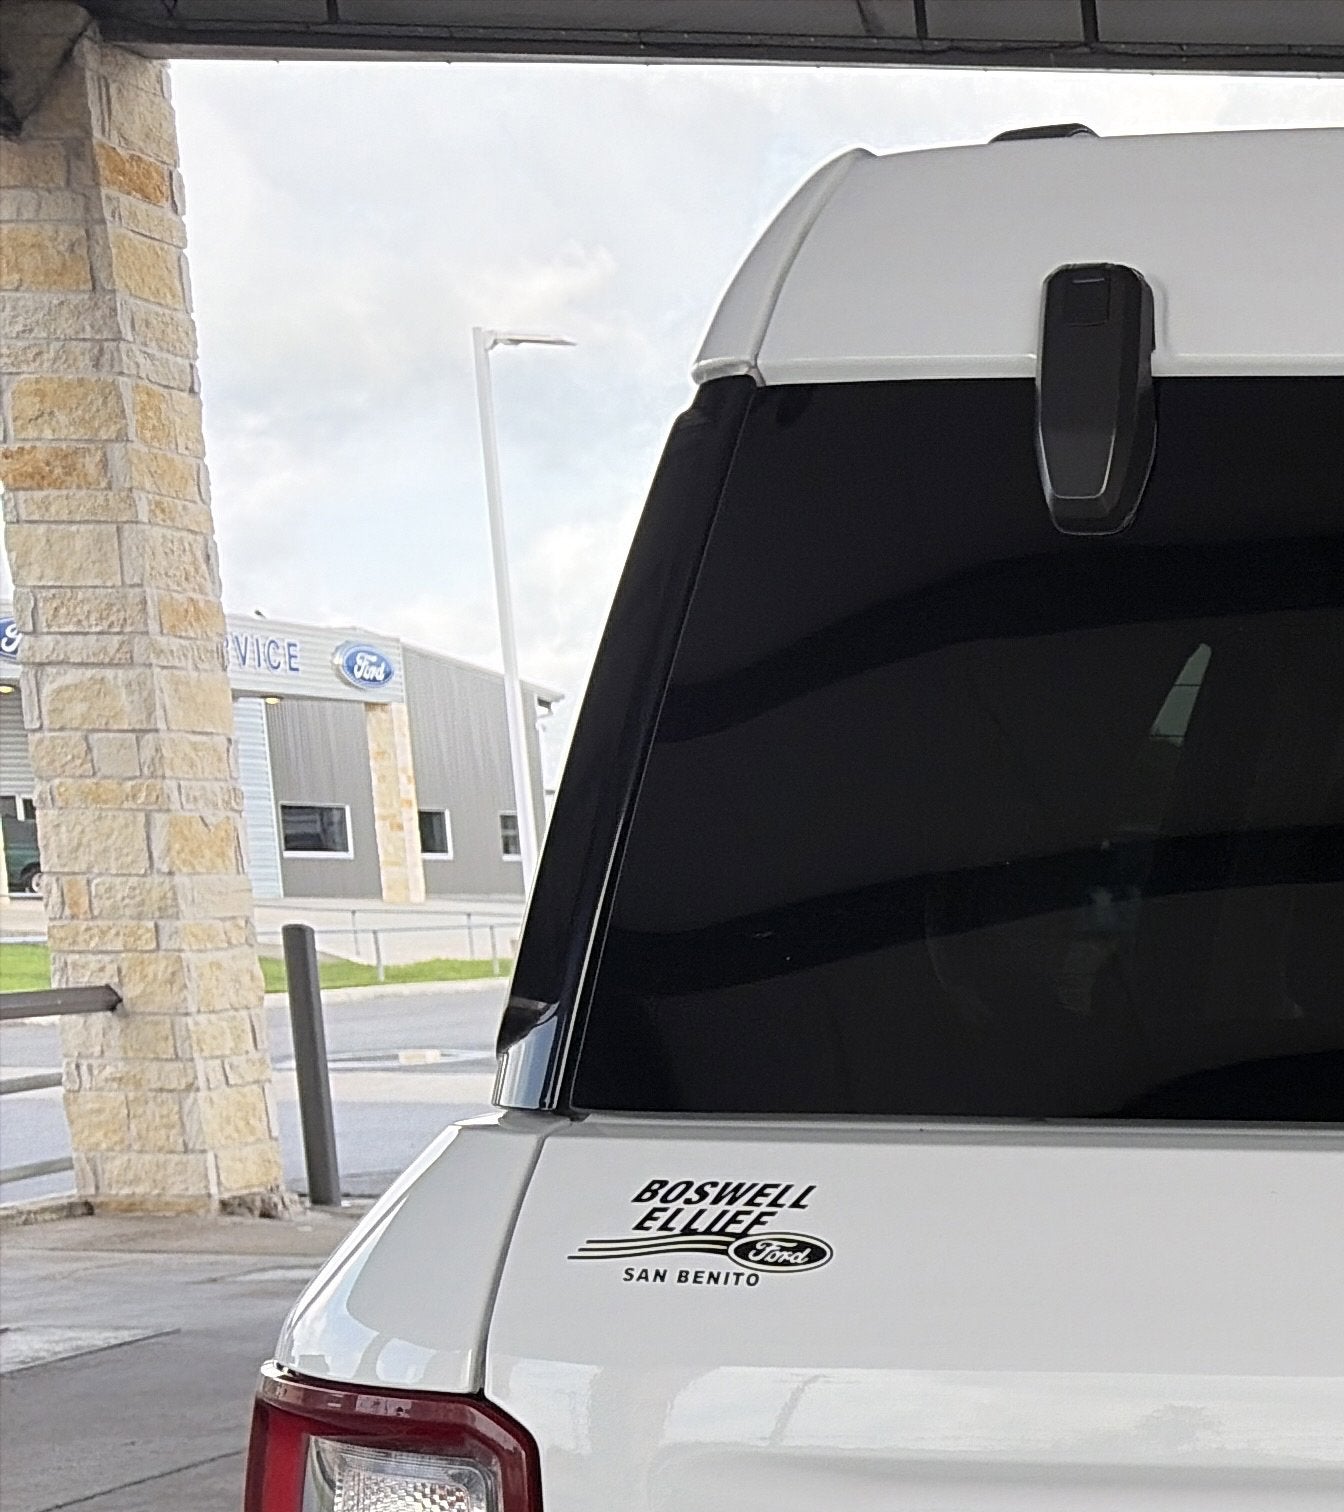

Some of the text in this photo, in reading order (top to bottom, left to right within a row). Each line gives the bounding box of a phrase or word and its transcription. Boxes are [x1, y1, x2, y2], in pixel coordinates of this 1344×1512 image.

[353, 652, 385, 681] Ford
[630, 1179, 817, 1210] BOSWELL
[631, 1207, 779, 1235] ELLIFF
[747, 1239, 813, 1265] Ford
[622, 1267, 760, 1287] SAN BENITO
